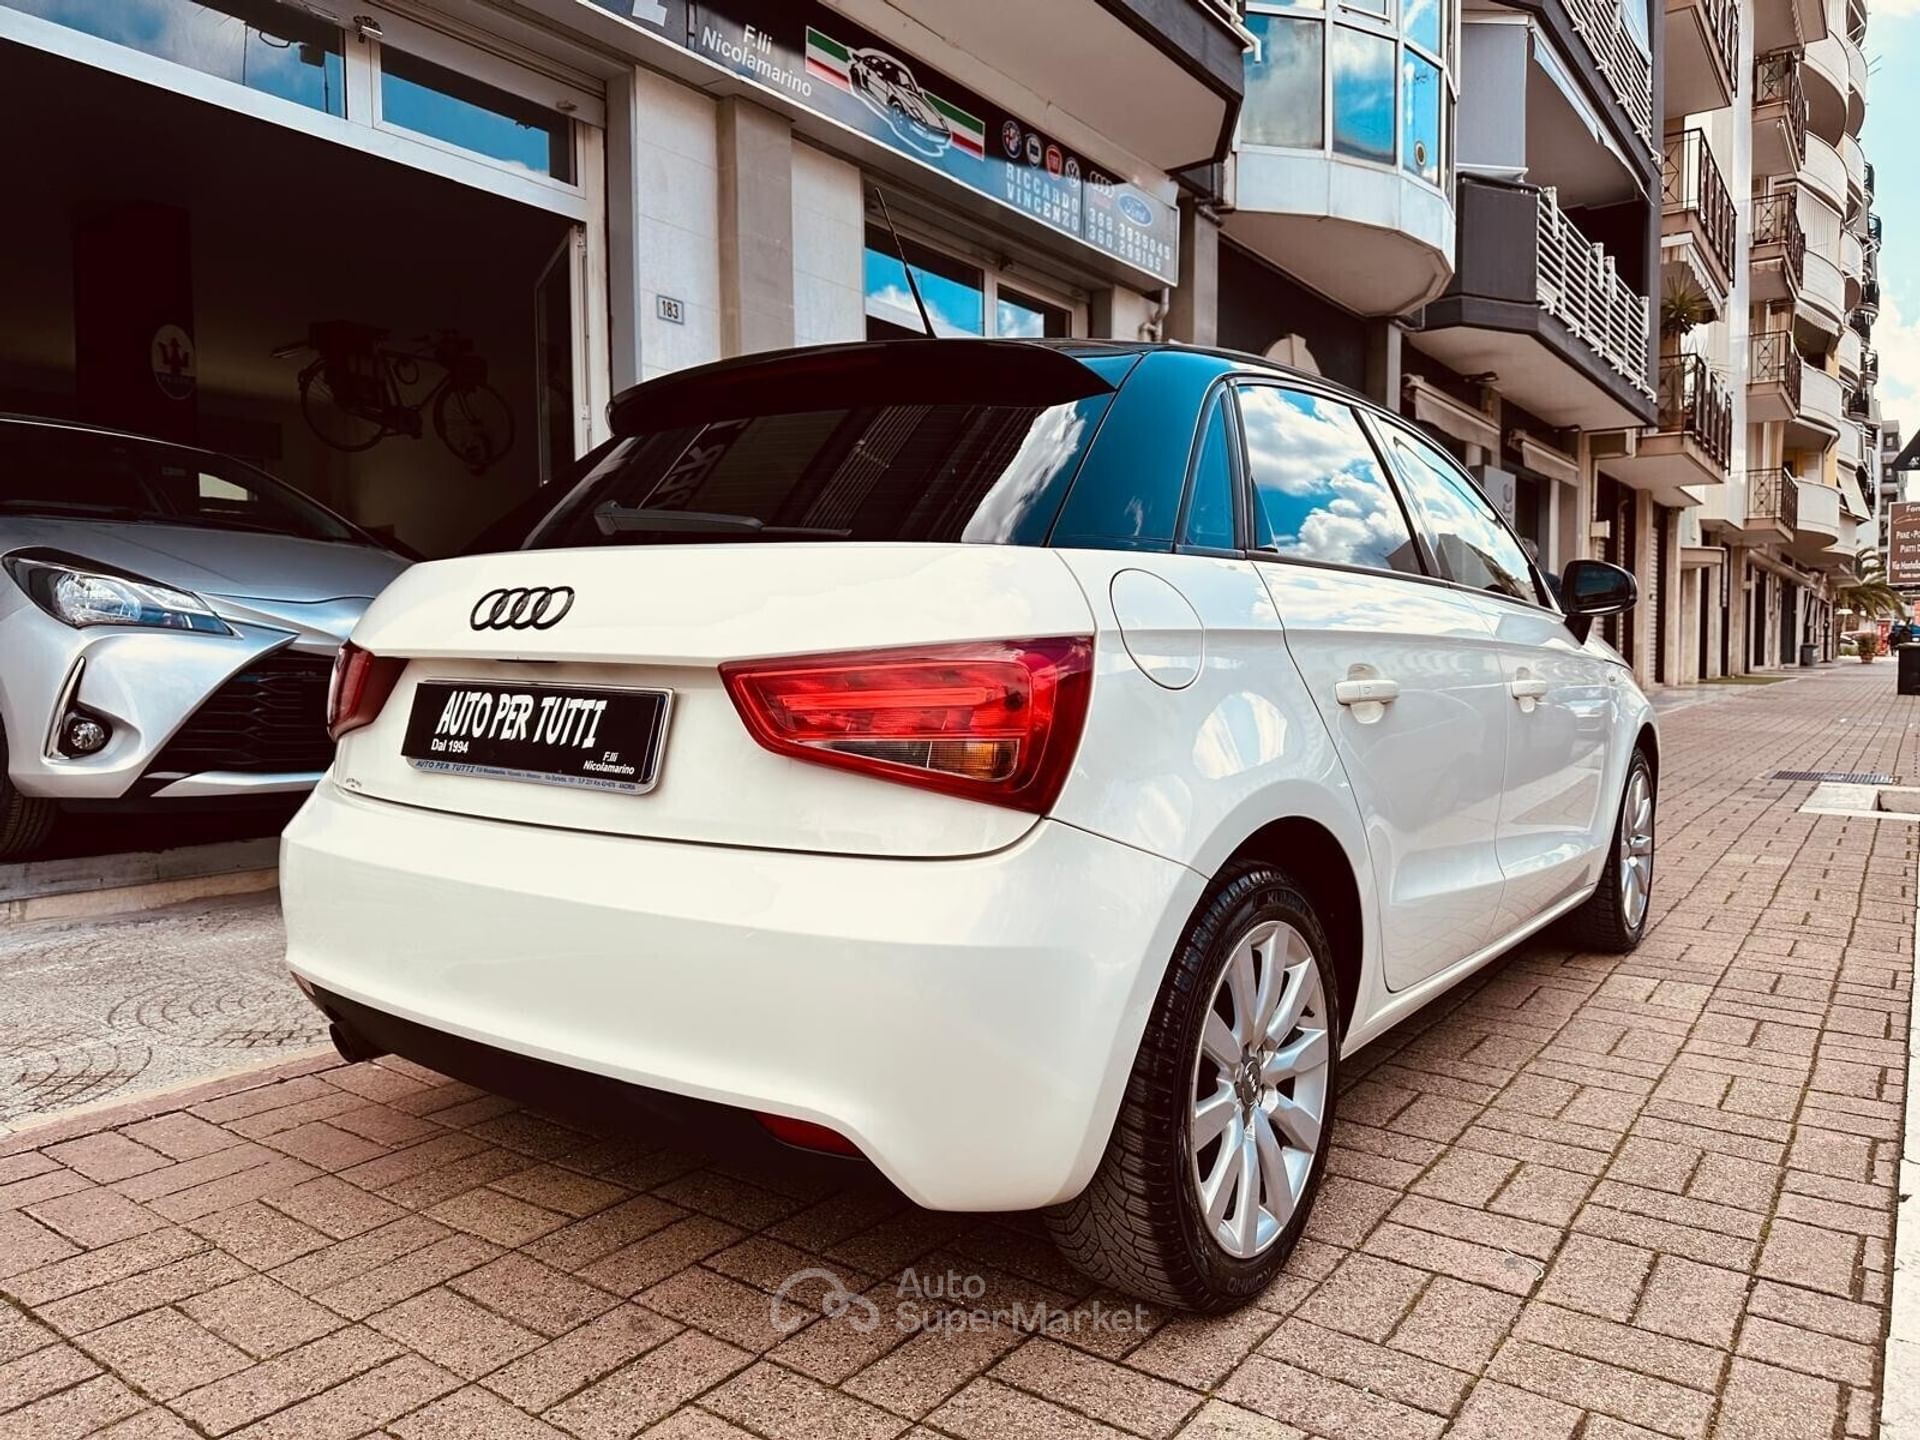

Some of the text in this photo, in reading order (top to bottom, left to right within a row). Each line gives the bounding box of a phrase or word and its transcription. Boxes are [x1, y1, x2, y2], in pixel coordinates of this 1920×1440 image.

[743, 24, 773, 54] F.lli
[702, 26, 812, 97] Nicolamarino
[1006, 162, 1079, 213] RICCARDO
[1006, 182, 1079, 231] VINCENZO
[662, 300, 679, 319] 183
[435, 691, 607, 749] AUTO PER TUTTI
[431, 738, 469, 754] Dal 1994
[416, 760, 434, 768] AUTO
[435, 761, 450, 769] PER
[452, 763, 475, 773] TUTTI
[583, 760, 635, 775] Nicolamarino
